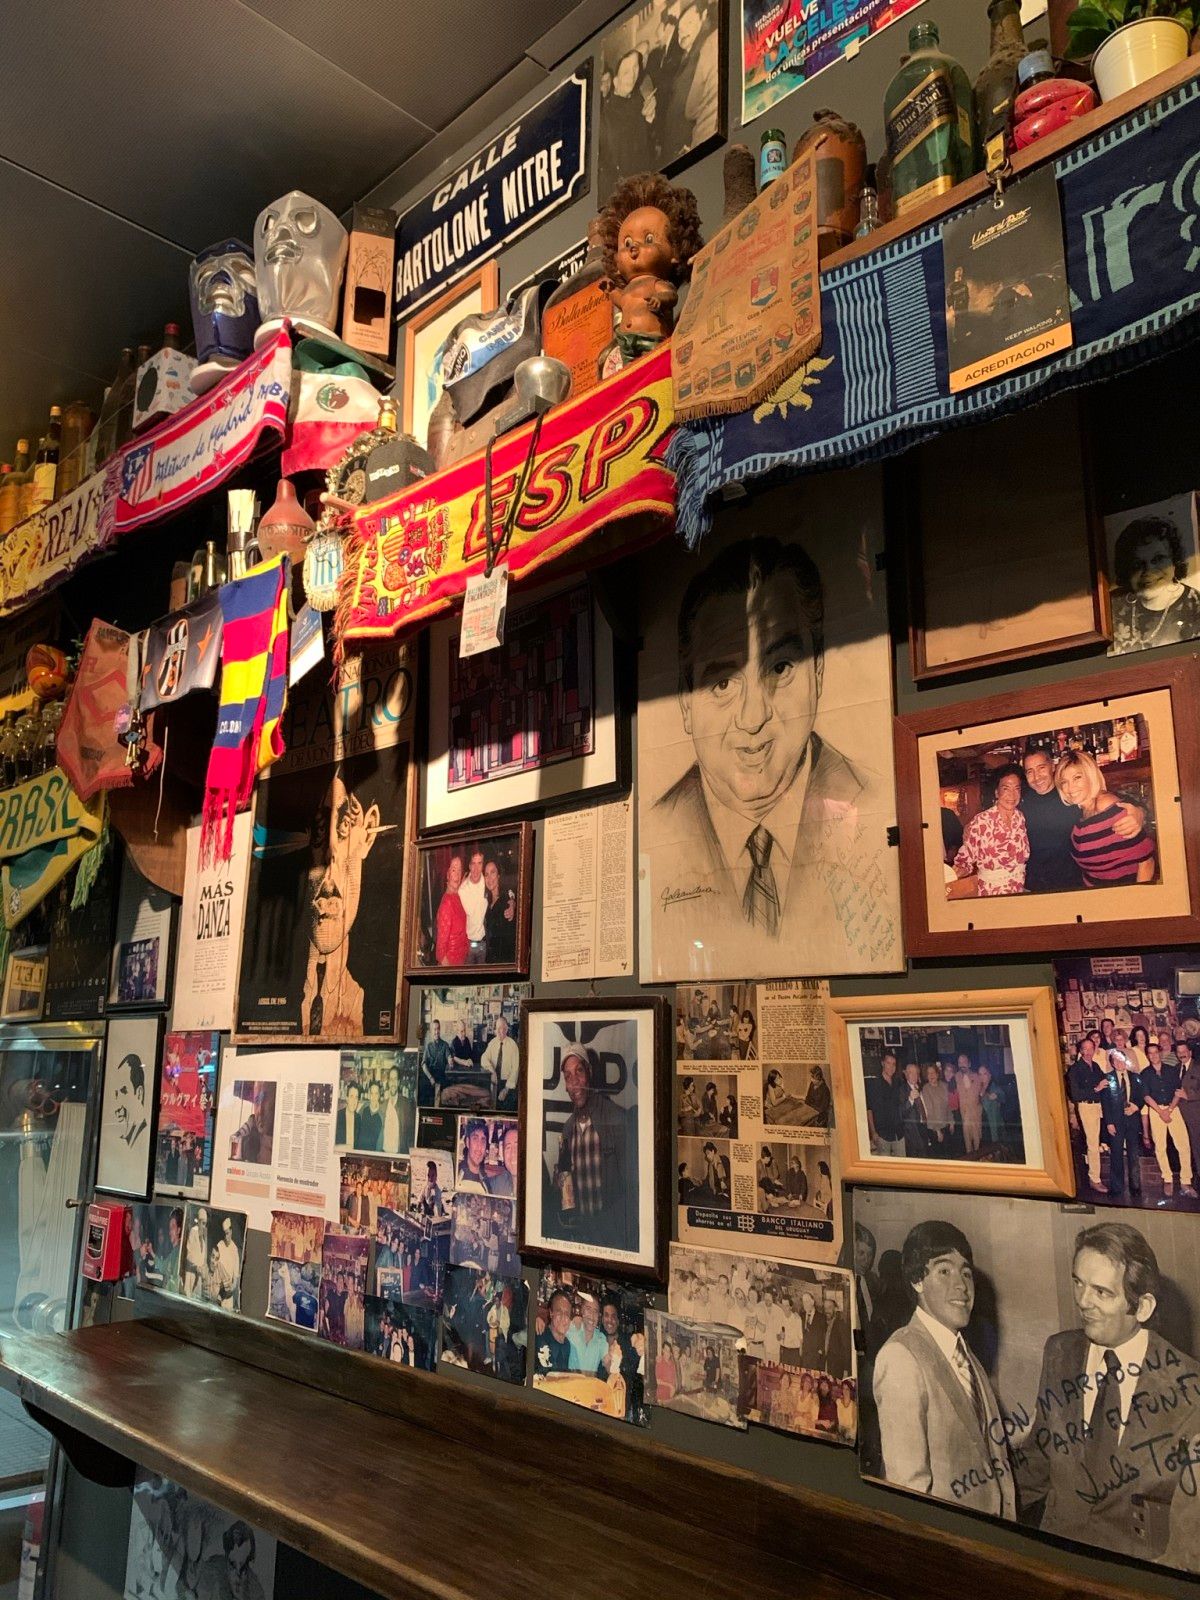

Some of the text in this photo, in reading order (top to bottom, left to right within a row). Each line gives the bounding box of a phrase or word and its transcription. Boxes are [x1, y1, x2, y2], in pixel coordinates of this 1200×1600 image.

[755, 4, 780, 28] urbano
[765, 0, 819, 48] VUELVE
[764, 41, 790, 72] LA
[895, 112, 917, 133] Blue
[916, 88, 942, 113] Label
[432, 125, 521, 213] CALLE
[396, 183, 491, 303] BARTOLOMÉ
[502, 140, 563, 225] MITRE
[1005, 317, 1053, 342] KEEP WALKING
[965, 338, 1055, 382] ACREDITACIÓN
[208, 385, 255, 447] Madrid
[41, 487, 95, 566] REAL
[289, 667, 414, 749] EATRO
[200, 879, 234, 901] MÁS
[197, 899, 231, 940] DANZA
[761, 1216, 824, 1230] BANCO ITALIANO
[989, 1348, 1182, 1446] CON MARADONA
[1035, 1419, 1094, 1460] PARA
[1106, 1408, 1130, 1431] EL
